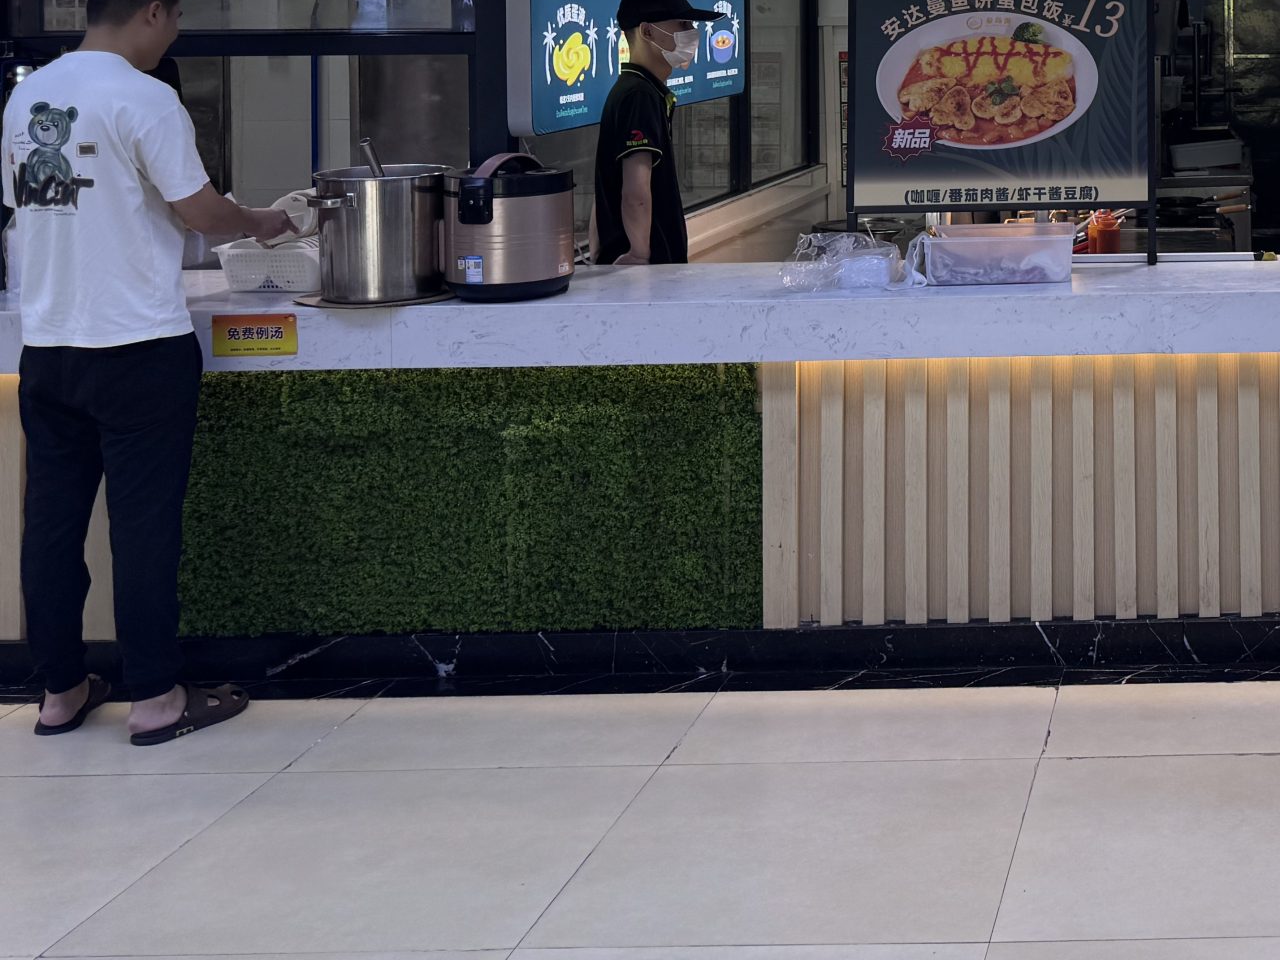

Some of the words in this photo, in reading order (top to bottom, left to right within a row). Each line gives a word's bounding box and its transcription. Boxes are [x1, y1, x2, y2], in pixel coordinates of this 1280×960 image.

[891, 128, 931, 149] 新品
[904, 185, 1100, 206] (咖喱/番茄肉酱/虾干酱豆腐)
[227, 326, 284, 340] 免费例汤
